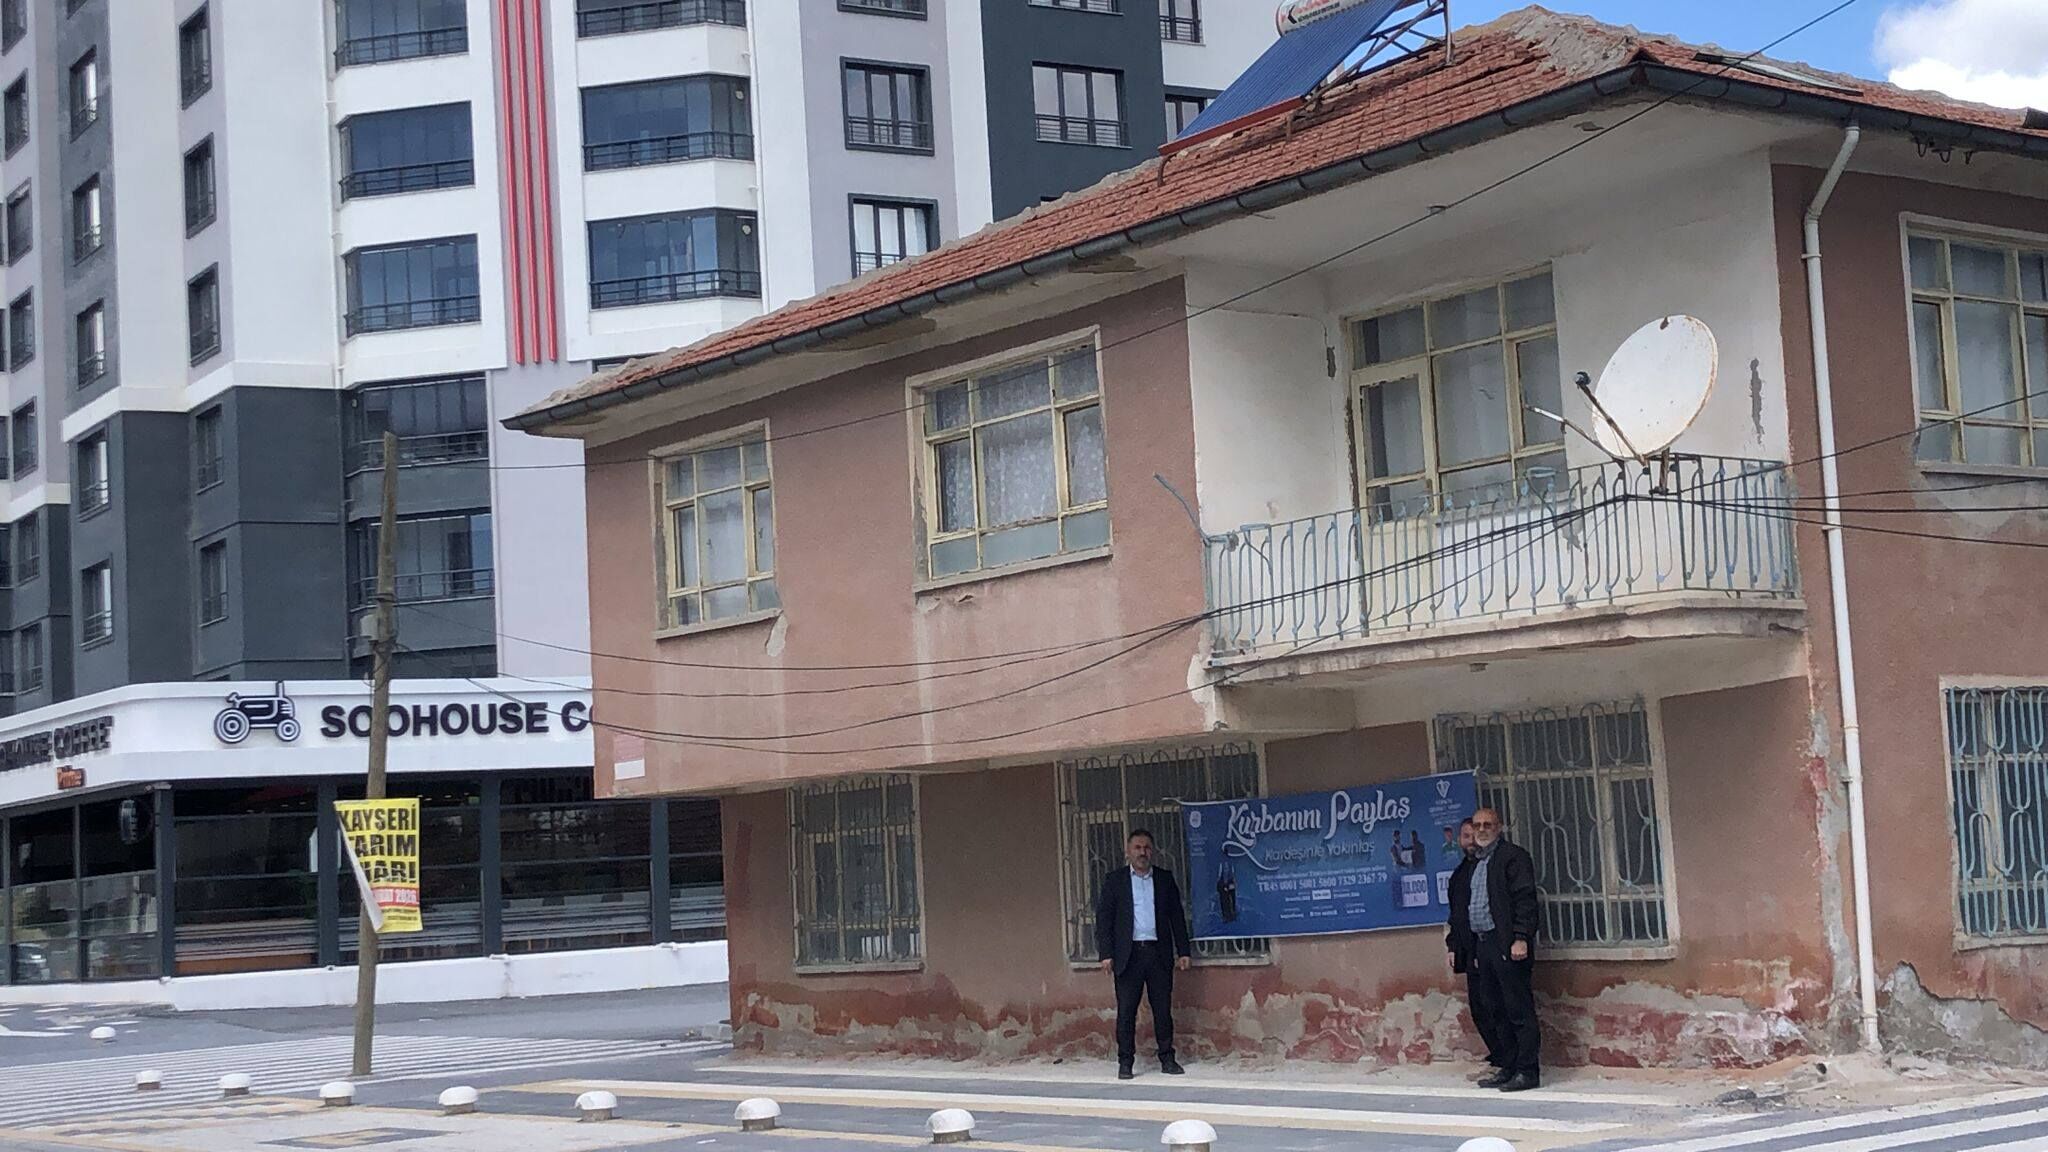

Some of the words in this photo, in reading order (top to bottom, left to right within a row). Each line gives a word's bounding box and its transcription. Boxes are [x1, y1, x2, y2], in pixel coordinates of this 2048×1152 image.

[320, 702, 549, 738] SOOHOUSE
[561, 700, 593, 732] C
[1223, 802, 1322, 848] Kurbanını
[1323, 789, 1411, 840] Paylaş
